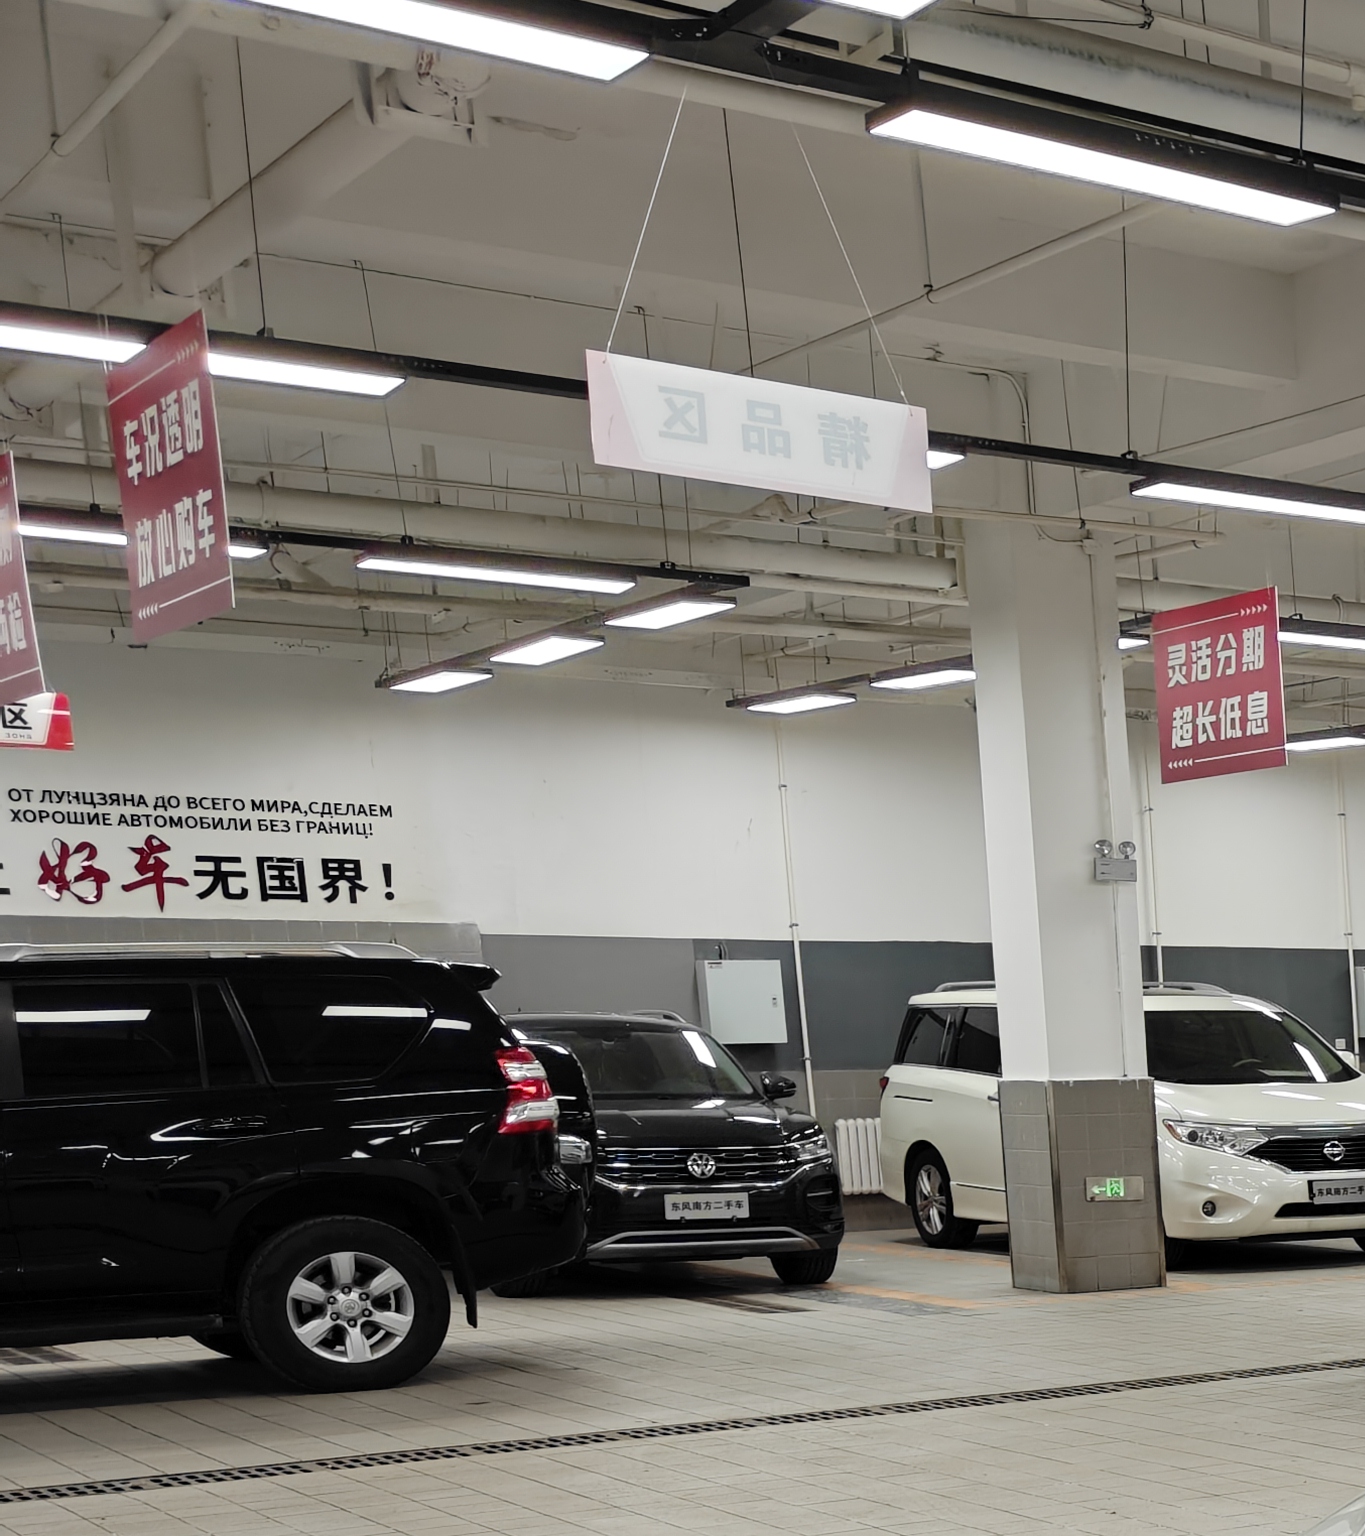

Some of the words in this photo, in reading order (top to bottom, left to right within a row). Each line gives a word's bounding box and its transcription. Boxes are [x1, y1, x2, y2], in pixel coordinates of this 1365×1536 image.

[123, 378, 203, 486] 车况透明
[135, 488, 216, 588] 放心购车
[1167, 624, 1266, 690] 灵活分期
[1171, 690, 1270, 750] 超长低息
[8, 788, 34, 803] ОТ
[39, 789, 149, 809] ЛУНЦЗЯНА
[153, 795, 181, 812] ДО
[186, 796, 246, 812] ВСЕГО
[10, 809, 113, 827] ХОРОШИЕ
[118, 813, 252, 832] АВТОМОБИЛИ
[257, 819, 291, 833] БЕЗ
[296, 821, 374, 839] ГРАНИЦ!
[671, 1200, 744, 1212] 东风南方二手车
